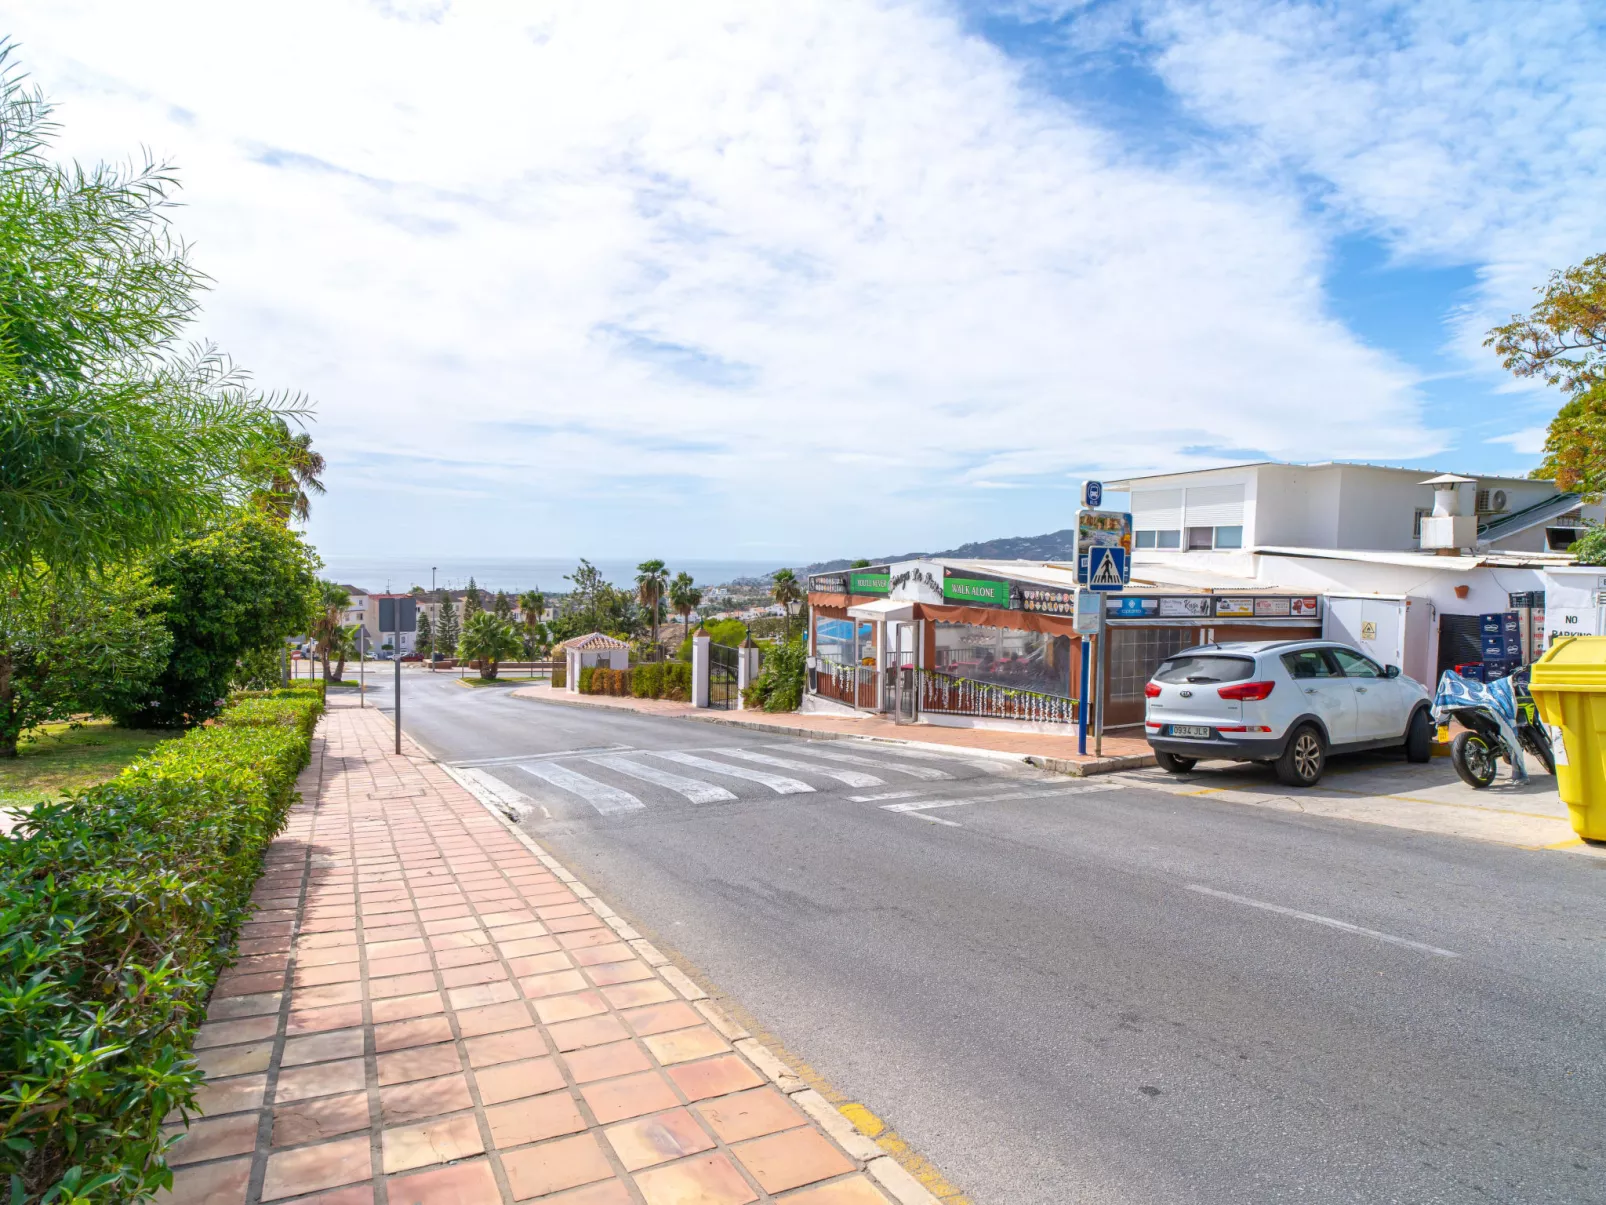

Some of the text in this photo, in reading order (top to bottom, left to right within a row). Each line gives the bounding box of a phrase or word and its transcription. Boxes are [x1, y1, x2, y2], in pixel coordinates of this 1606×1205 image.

[872, 579, 886, 587] NEVER
[951, 583, 995, 598] WALK ALONE
[1565, 615, 1578, 624] NO
[1173, 726, 1208, 736] 0934 JLR
